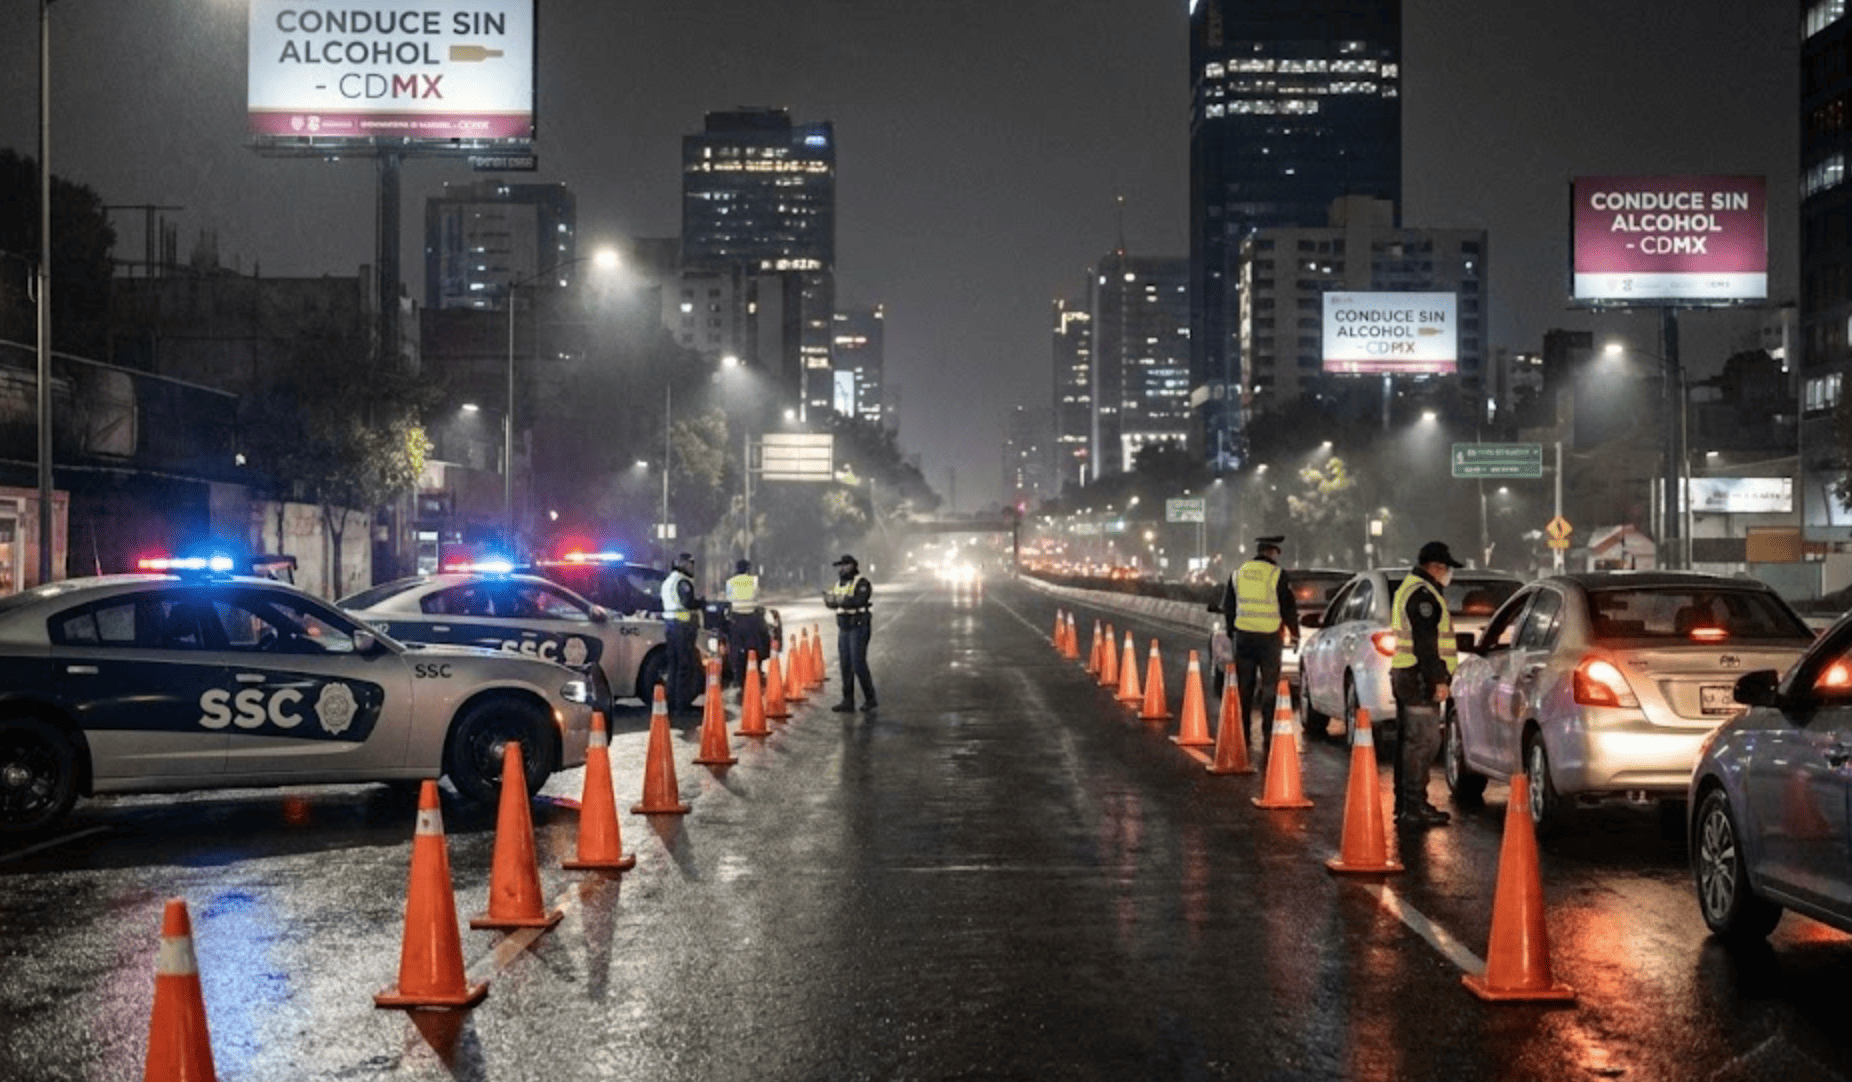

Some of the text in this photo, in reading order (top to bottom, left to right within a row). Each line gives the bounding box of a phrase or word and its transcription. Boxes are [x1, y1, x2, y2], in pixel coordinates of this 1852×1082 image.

[276, 10, 506, 35] CONDUCE SIN
[278, 40, 441, 65] ALCOHOL
[339, 73, 444, 99] CDMX
[1591, 192, 1749, 210] CONDUCE SIN
[1611, 214, 1723, 232] ALCOHOL
[1640, 236, 1708, 255] CDMX
[1335, 309, 1446, 323] CONDUCE SIN
[1337, 325, 1414, 338] ALCOHOL
[415, 663, 452, 679] SSC
[199, 688, 304, 730] SSC
